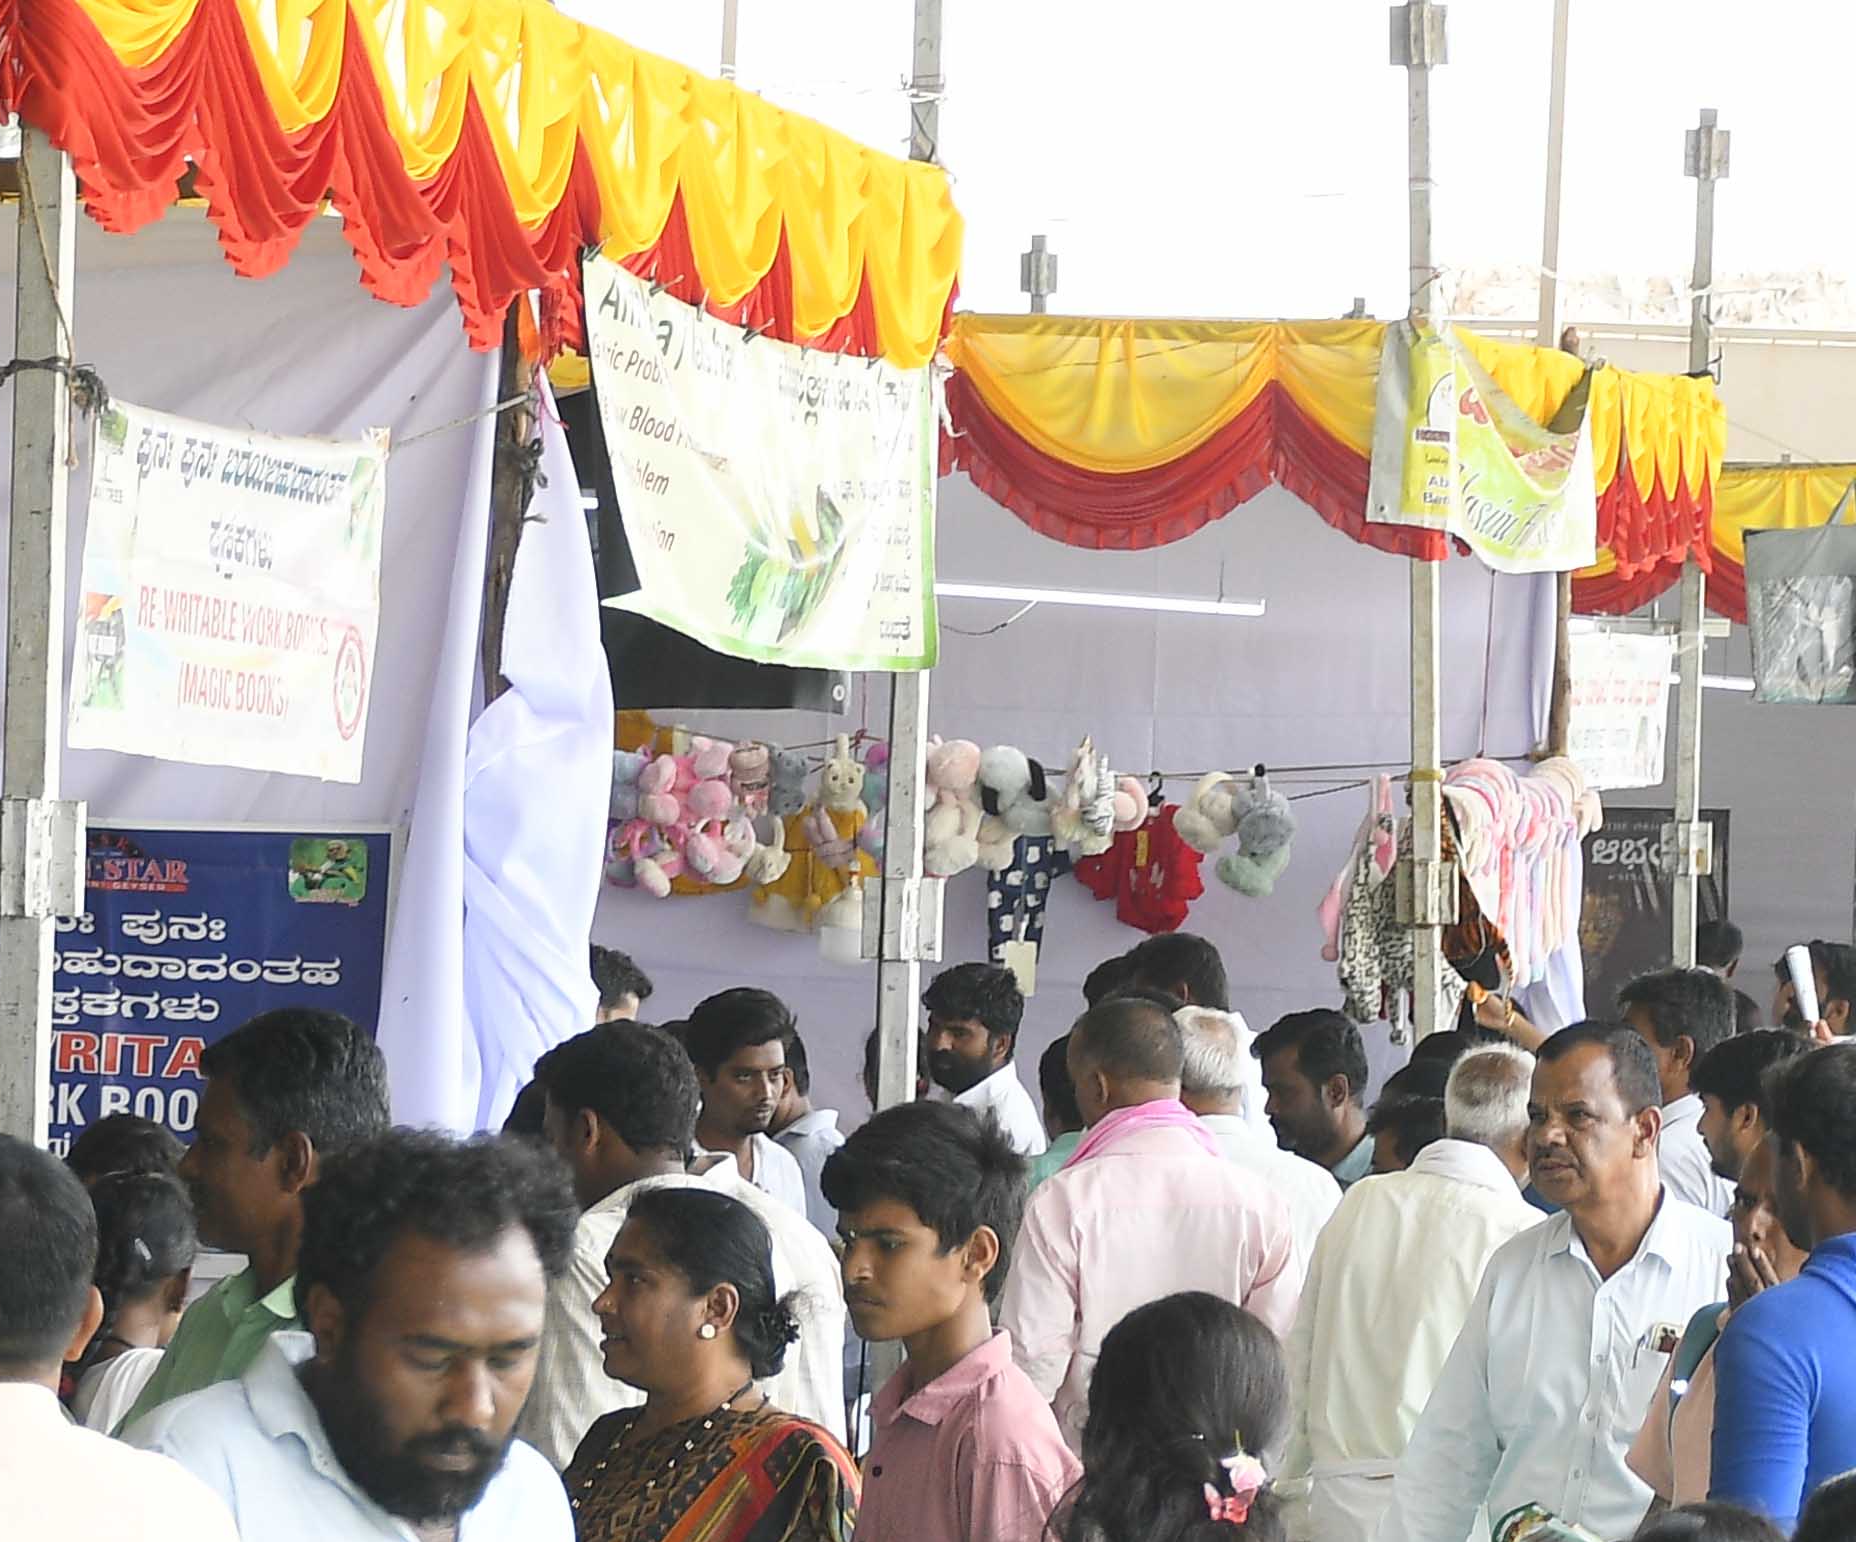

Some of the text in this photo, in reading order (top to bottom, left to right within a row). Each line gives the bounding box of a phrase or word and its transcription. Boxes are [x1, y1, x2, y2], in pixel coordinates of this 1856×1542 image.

[629, 404, 676, 443] Blood
[103, 856, 189, 884] STAR
[121, 909, 228, 946] ಪುನಃ
[100, 1084, 198, 1131] BOO
